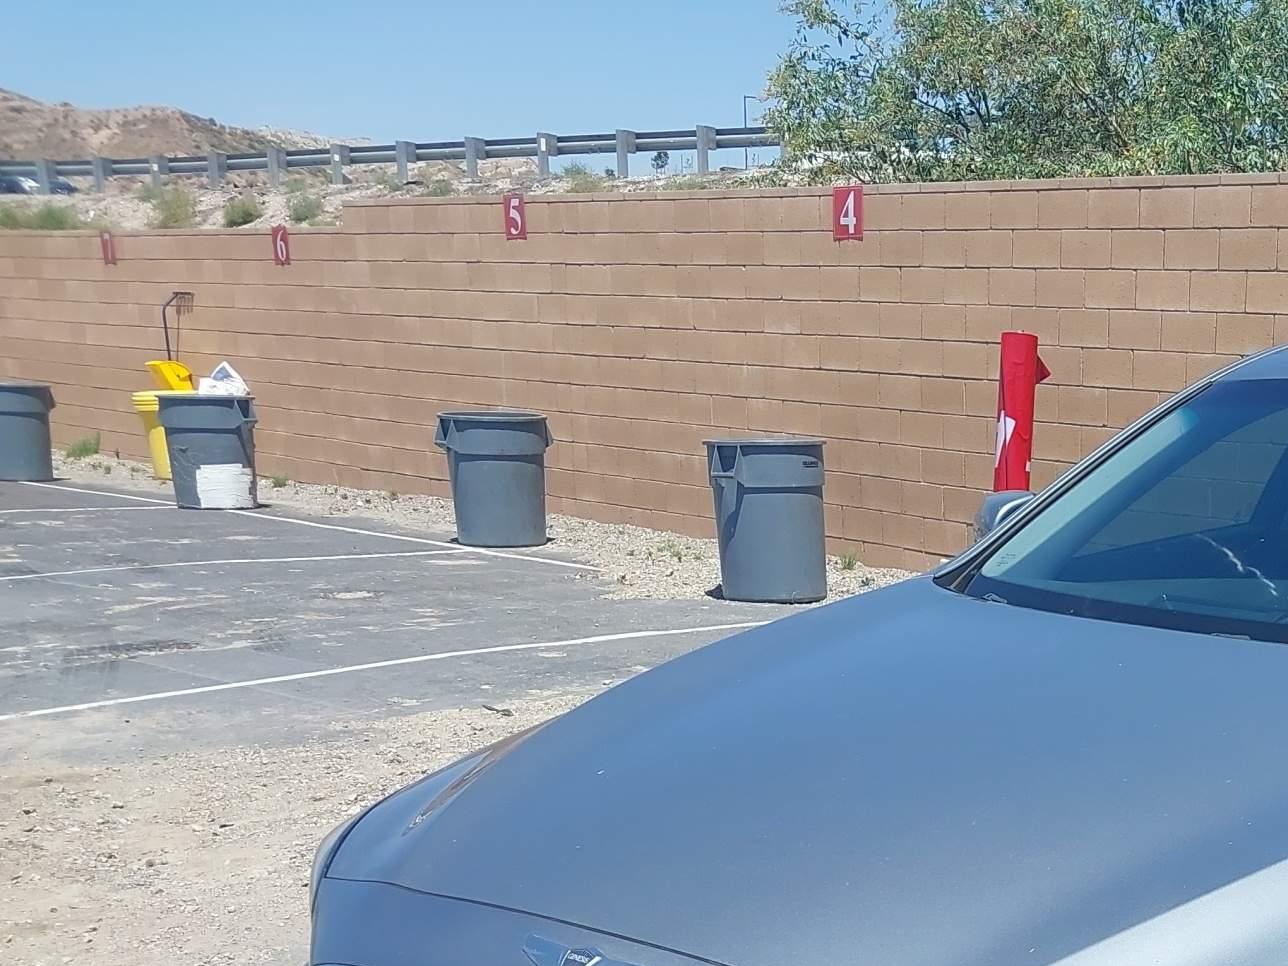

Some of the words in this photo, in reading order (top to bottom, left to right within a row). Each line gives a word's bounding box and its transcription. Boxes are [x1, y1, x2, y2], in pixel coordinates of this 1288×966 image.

[509, 198, 522, 235] 5
[839, 190, 857, 235] 4
[276, 230, 287, 262] 6
